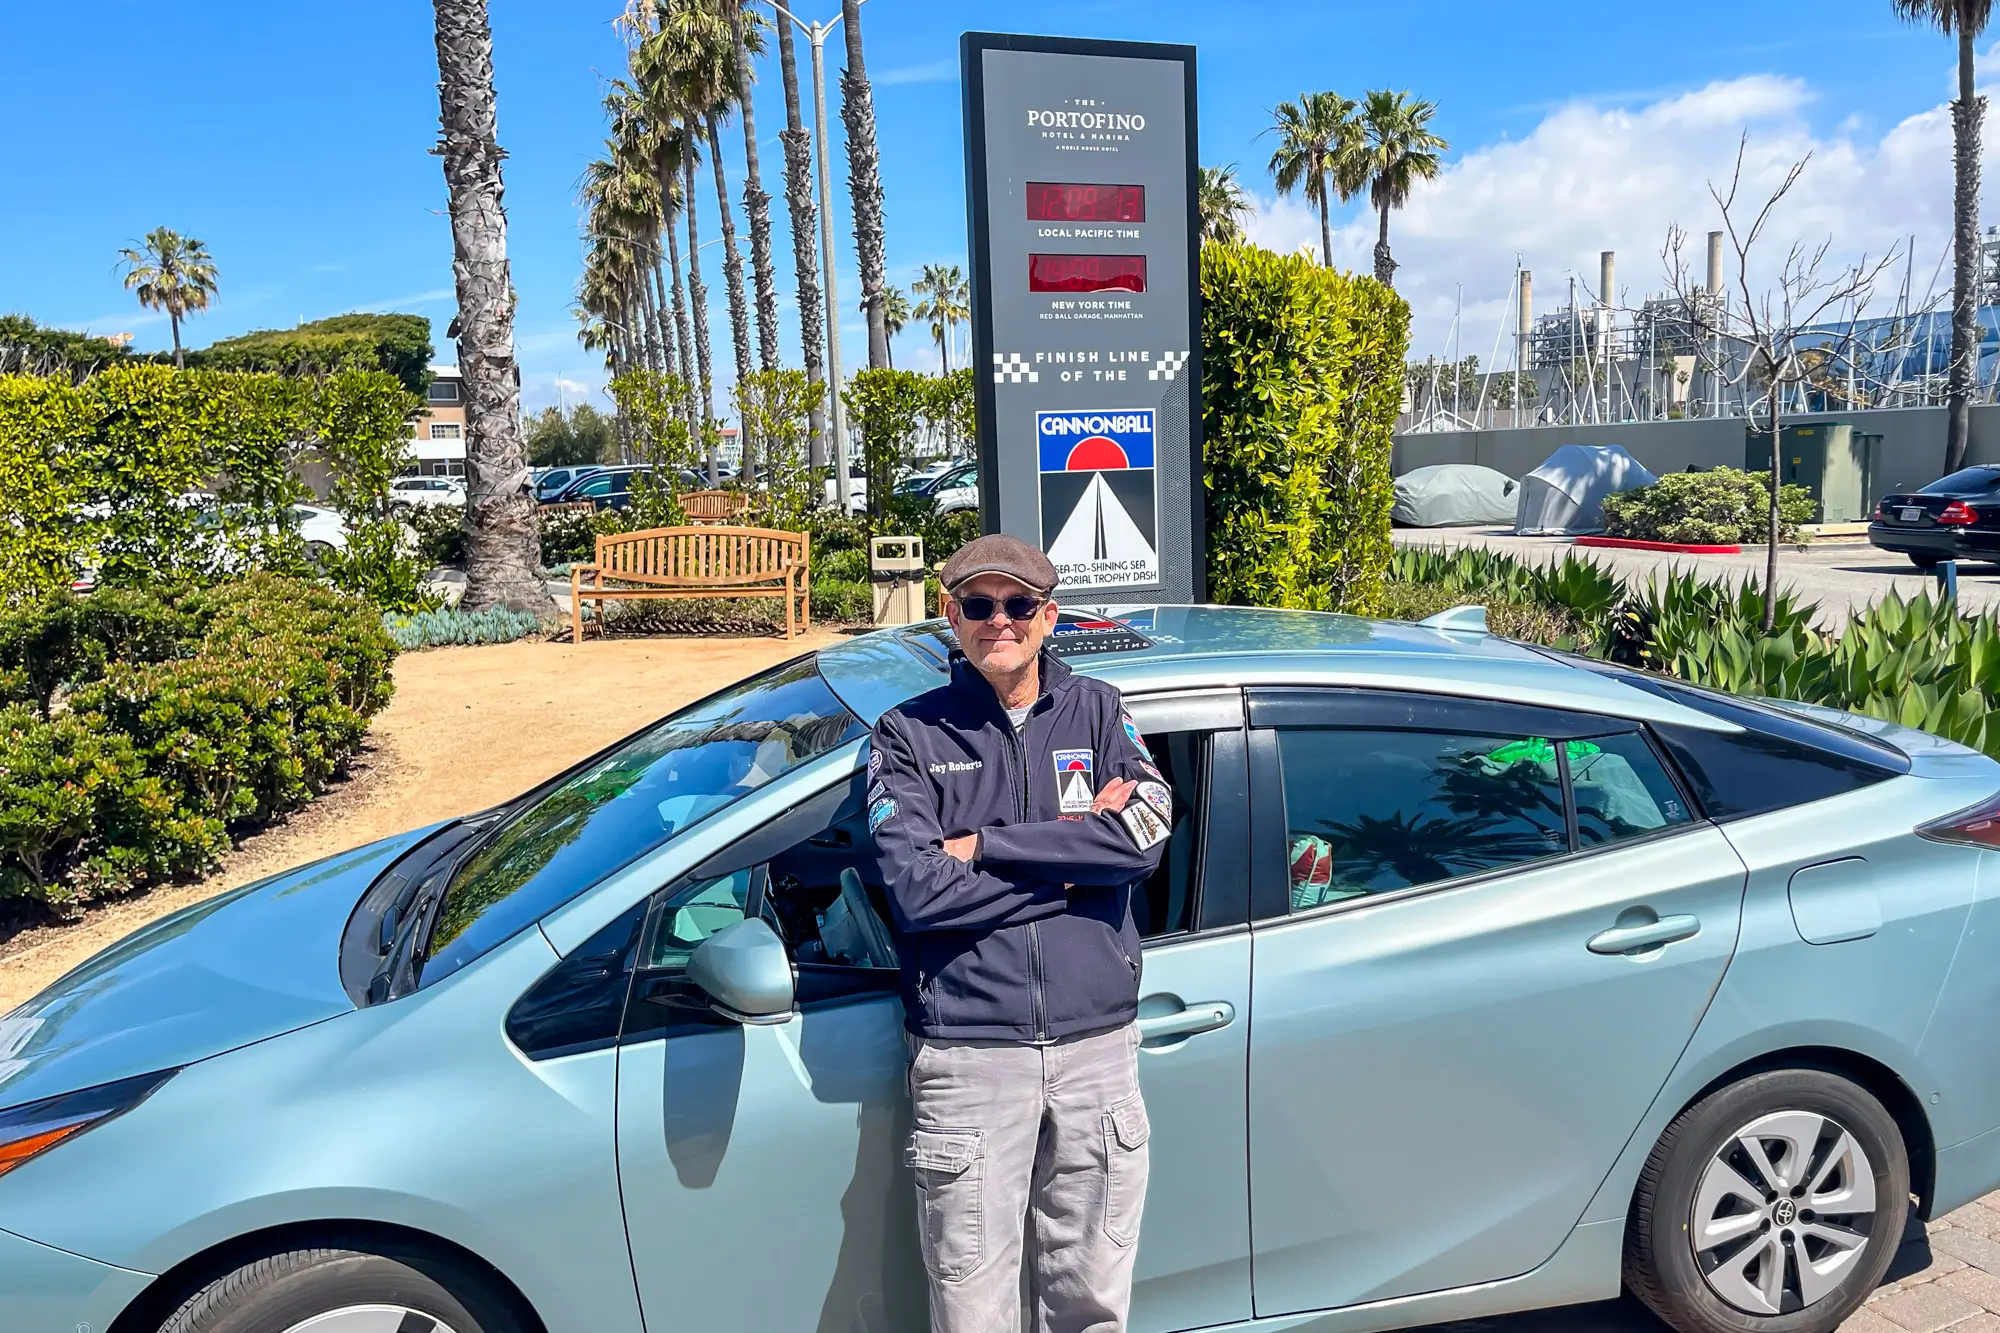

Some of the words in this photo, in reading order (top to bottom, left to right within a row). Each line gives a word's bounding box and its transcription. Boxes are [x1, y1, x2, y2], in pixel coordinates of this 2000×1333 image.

[1027, 110, 1146, 130] PORTOFINO
[1092, 133, 1129, 141] MARINA
[1038, 229, 1071, 237] LOCAL
[1075, 229, 1113, 238] PACIFIC
[1117, 230, 1140, 238] TIME
[1052, 301, 1075, 309] NEW
[1036, 352, 1099, 363] FINISH
[1109, 351, 1150, 362] LINE
[1060, 371, 1083, 382] OF
[1093, 370, 1127, 381] THE
[1040, 415, 1152, 435] CANNONBALL
[1130, 560, 1146, 569] SEA
[1094, 572, 1131, 583] TROPHY
[1133, 571, 1157, 581] DASH
[930, 763, 946, 774] Jay
[948, 761, 982, 771] Roberts
